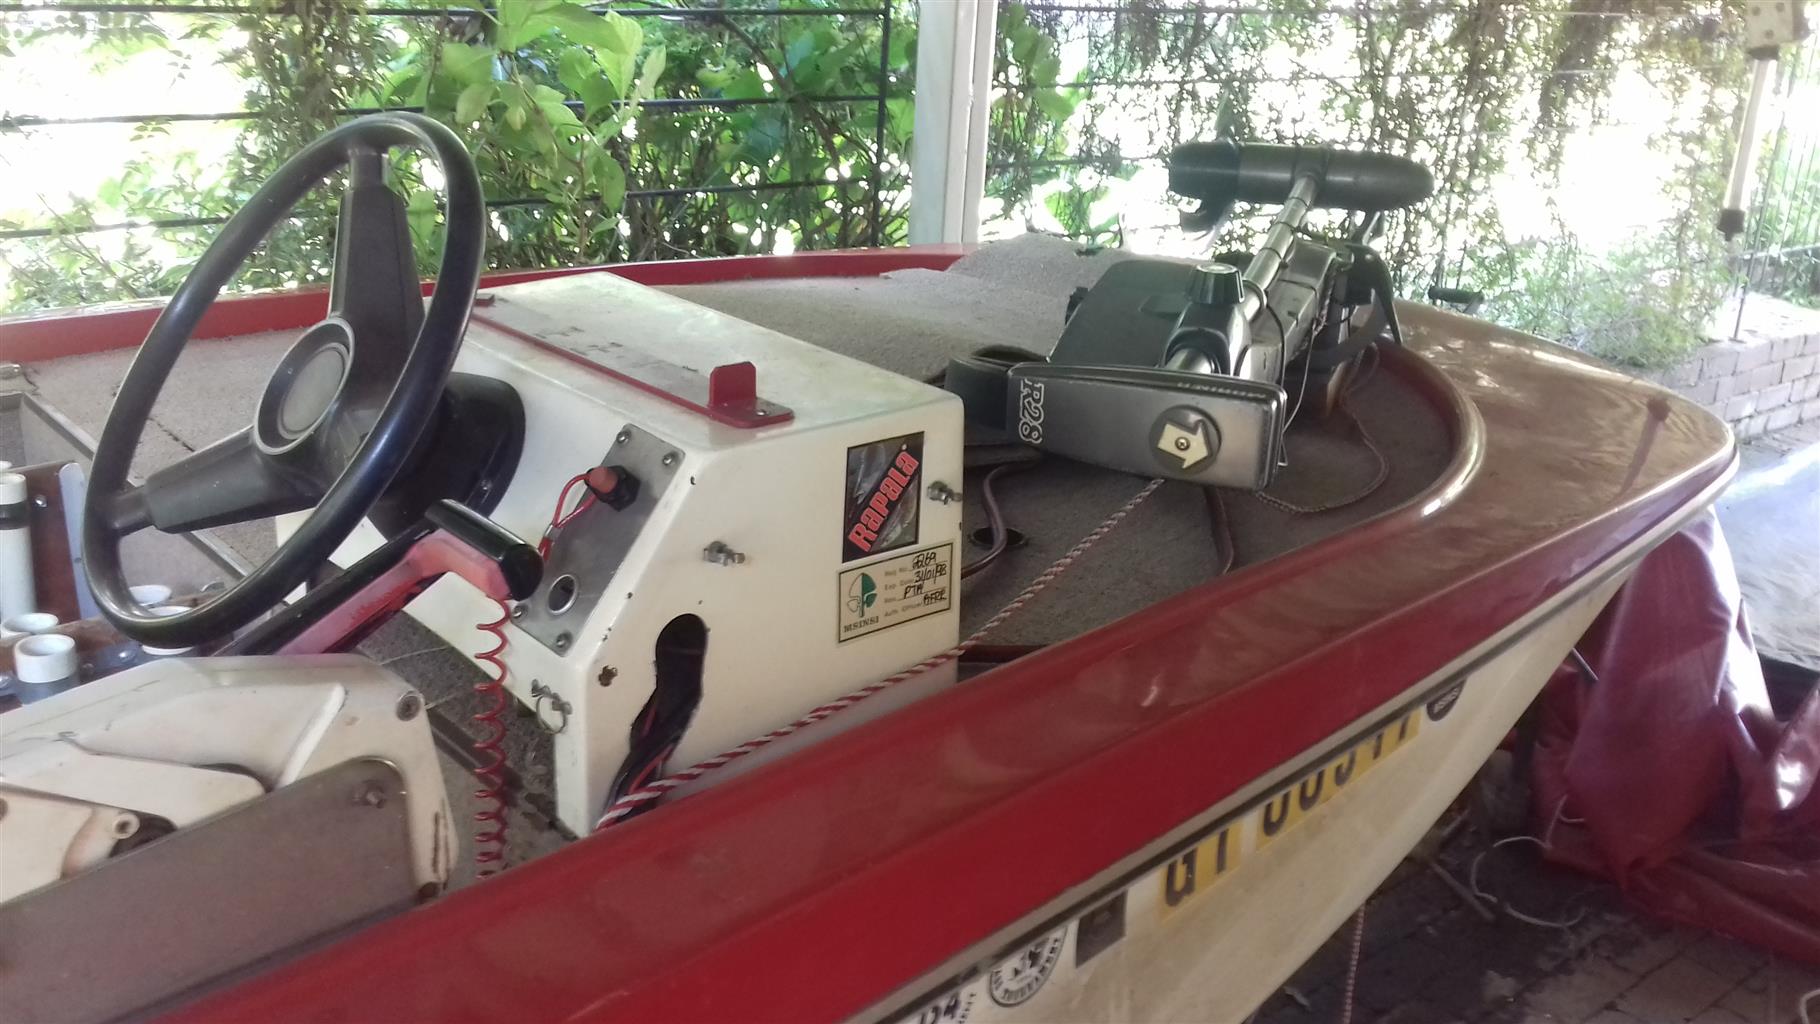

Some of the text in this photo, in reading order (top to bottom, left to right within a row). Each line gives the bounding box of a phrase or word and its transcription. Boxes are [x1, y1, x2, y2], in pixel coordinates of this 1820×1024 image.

[1018, 378, 1045, 445] R28
[848, 450, 920, 553] Rapala
[843, 615, 880, 633] MSINSI
